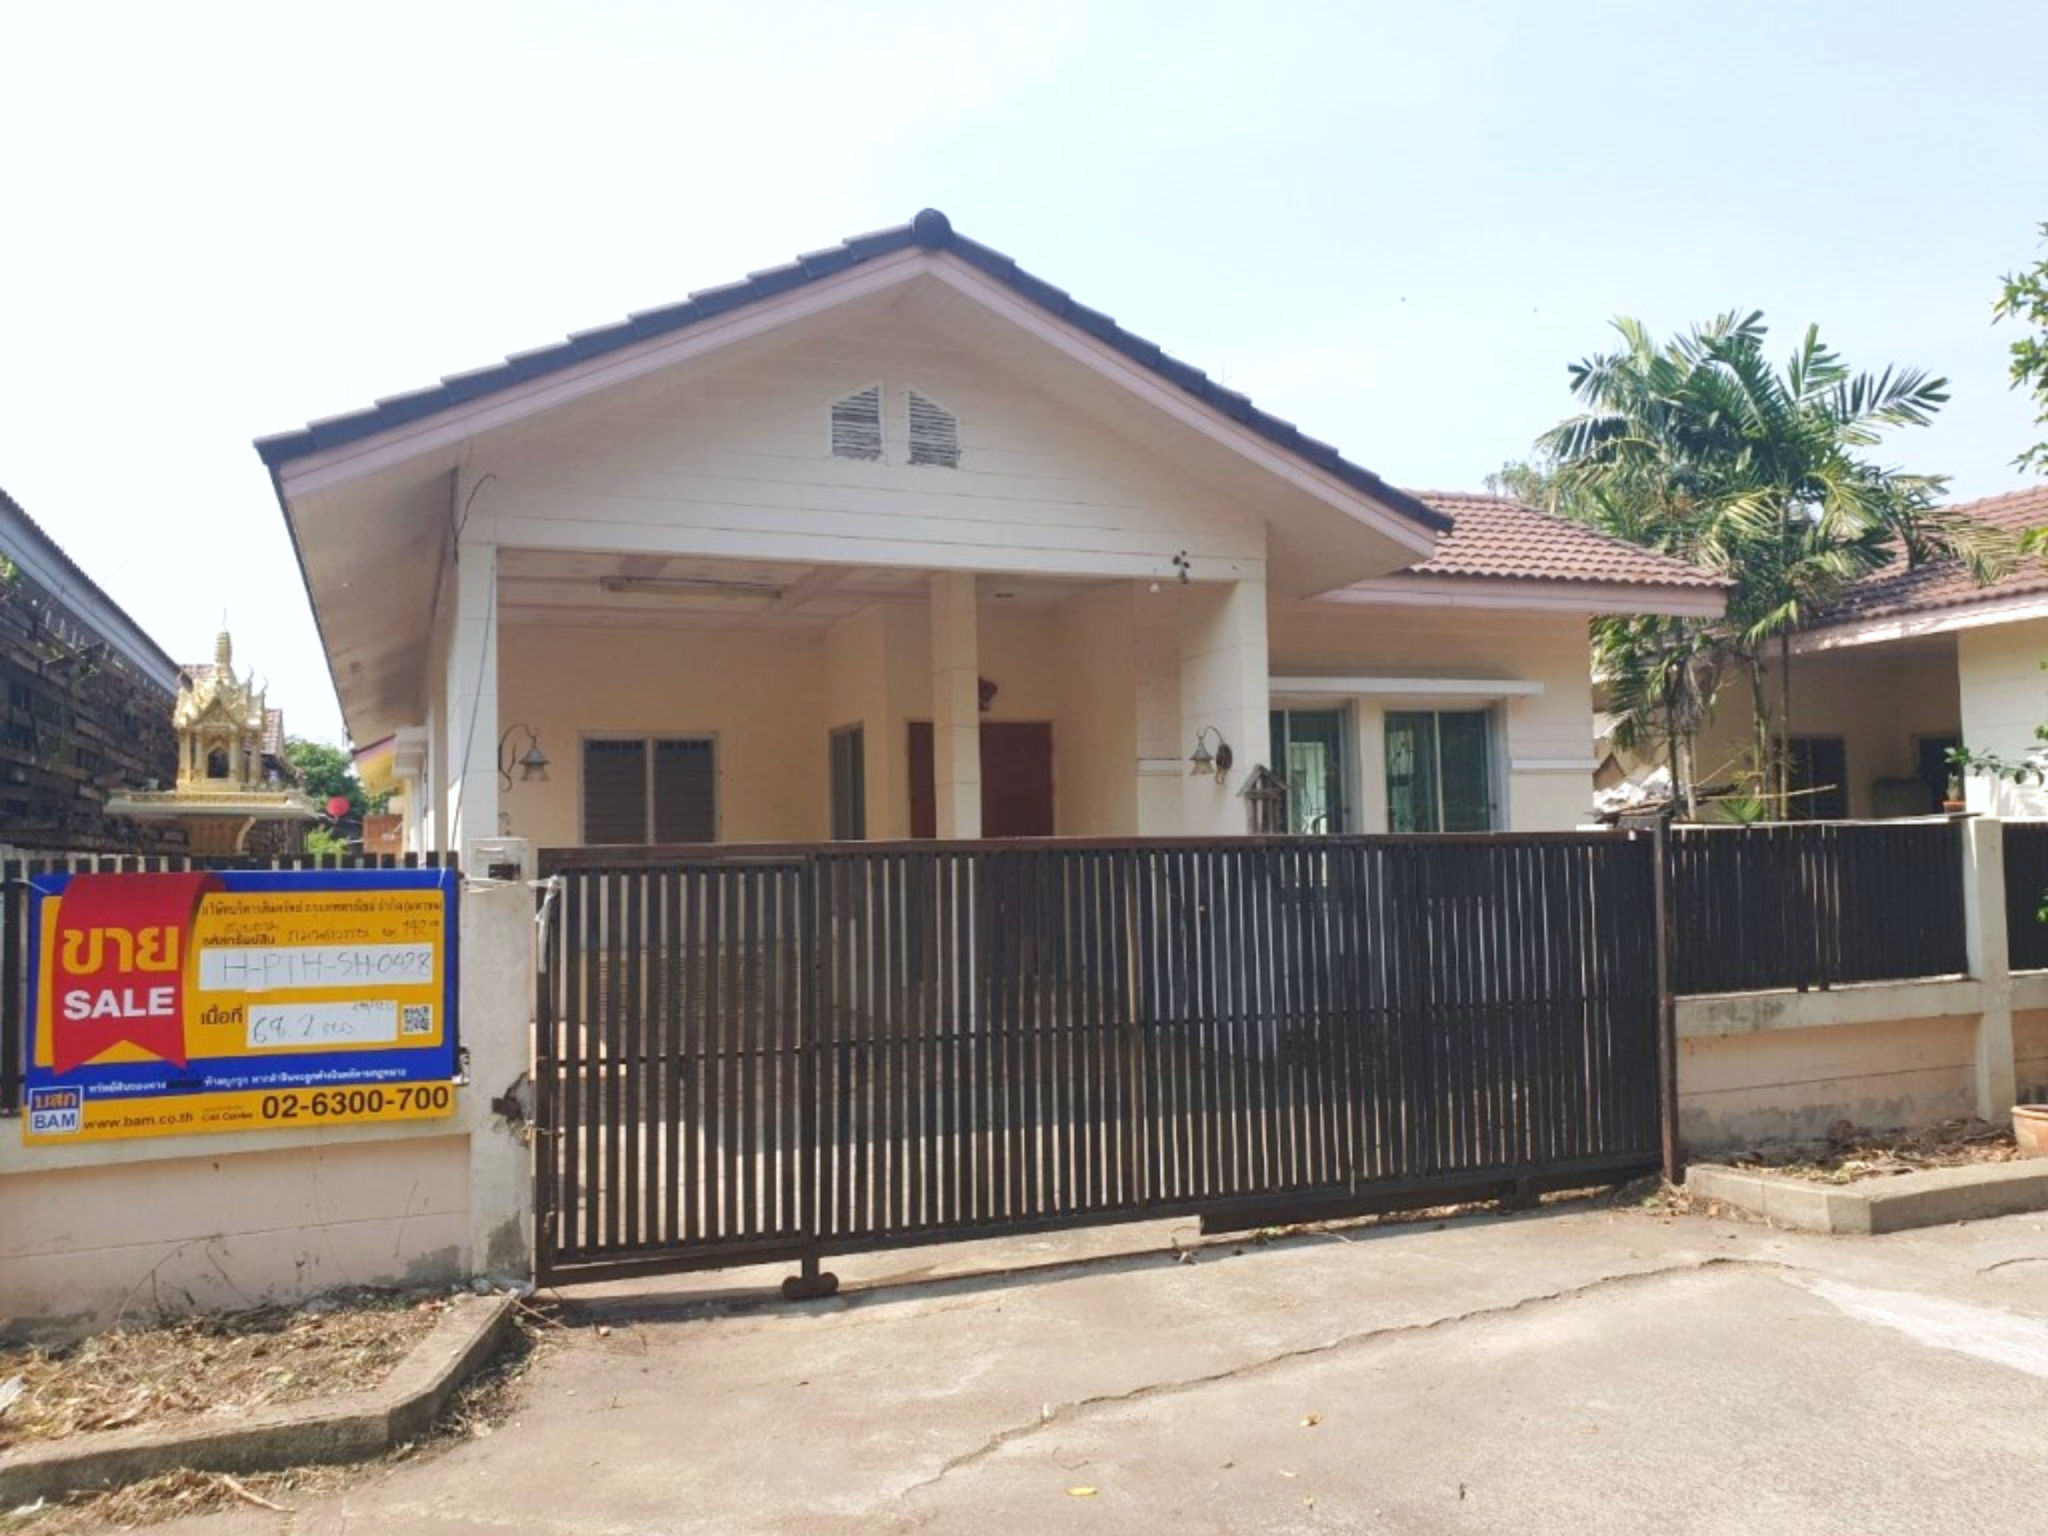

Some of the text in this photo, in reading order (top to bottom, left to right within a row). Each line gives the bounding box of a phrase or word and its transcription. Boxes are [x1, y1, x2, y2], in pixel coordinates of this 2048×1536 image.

[63, 927, 178, 974] ขาย
[63, 987, 174, 1020] SALE
[201, 1004, 243, 1025] เนื้อที่
[35, 1091, 77, 1109] บสก
[84, 1111, 194, 1130] www.bam.co.th
[262, 1086, 450, 1119] 02-6300-700
[33, 1112, 76, 1130] BAM
